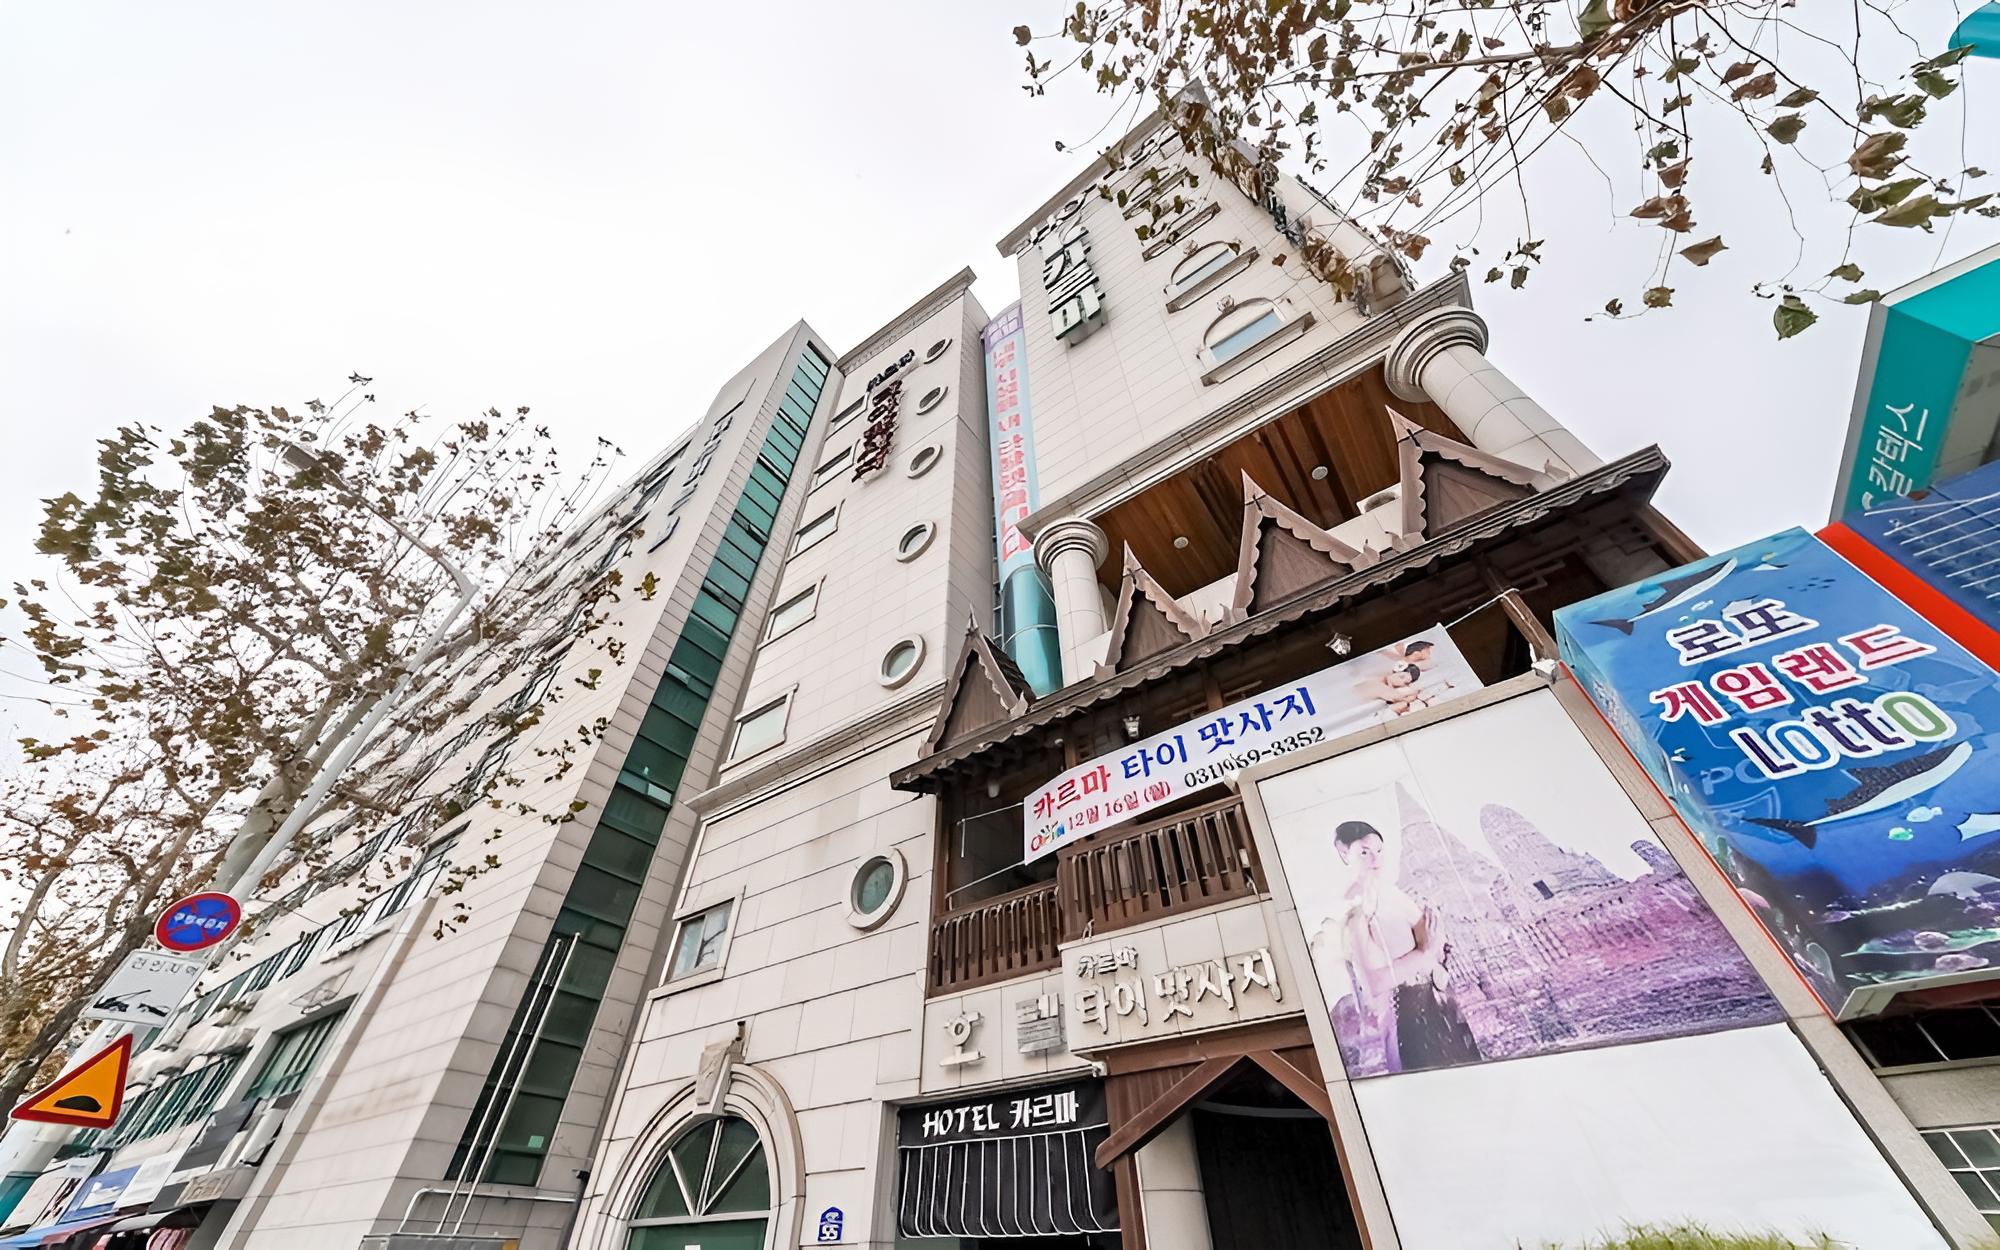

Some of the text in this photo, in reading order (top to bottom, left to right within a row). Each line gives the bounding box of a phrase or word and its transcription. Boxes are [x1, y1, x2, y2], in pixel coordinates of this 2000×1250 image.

[1669, 600, 1815, 664] 로또
[1653, 626, 1932, 724] 게임랜드
[1033, 686, 1316, 819] 카르마 타이 맛사지
[1105, 790, 1139, 817] 16일
[1074, 947, 1283, 1034] 타이 맛사지
[1078, 946, 1139, 979] 카르마
[922, 1090, 1079, 1138] HOTEL 카르마
